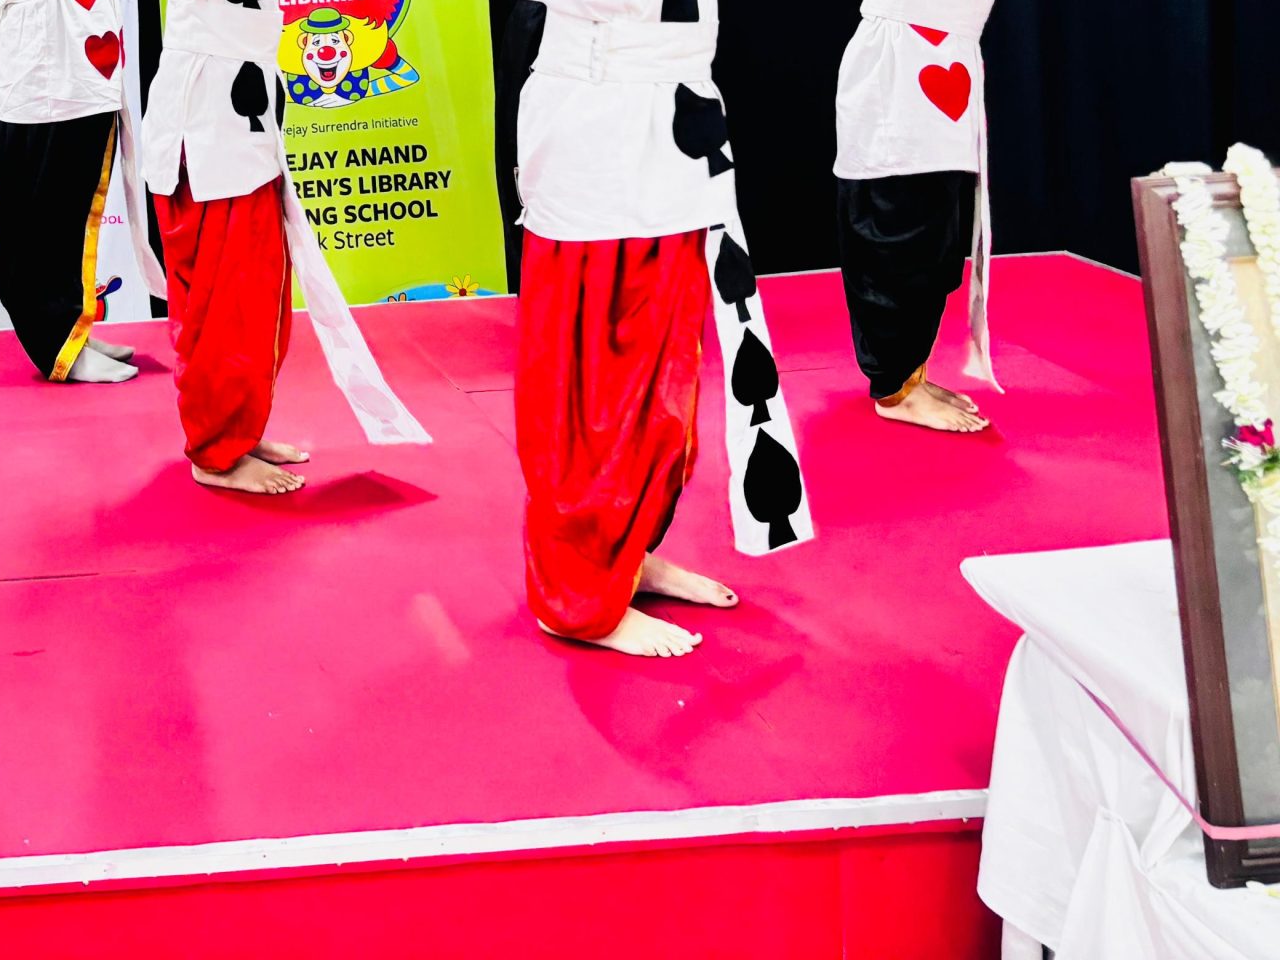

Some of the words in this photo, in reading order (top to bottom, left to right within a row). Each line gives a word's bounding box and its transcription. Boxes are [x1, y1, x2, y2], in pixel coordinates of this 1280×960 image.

[311, 120, 369, 134] Surrendra
[372, 117, 418, 129] Initiative
[286, 150, 338, 172] EJAY
[345, 144, 428, 168] ANAND
[359, 170, 452, 194] LIBRARY
[344, 199, 438, 224] SCHOOL
[334, 229, 395, 250] Street
